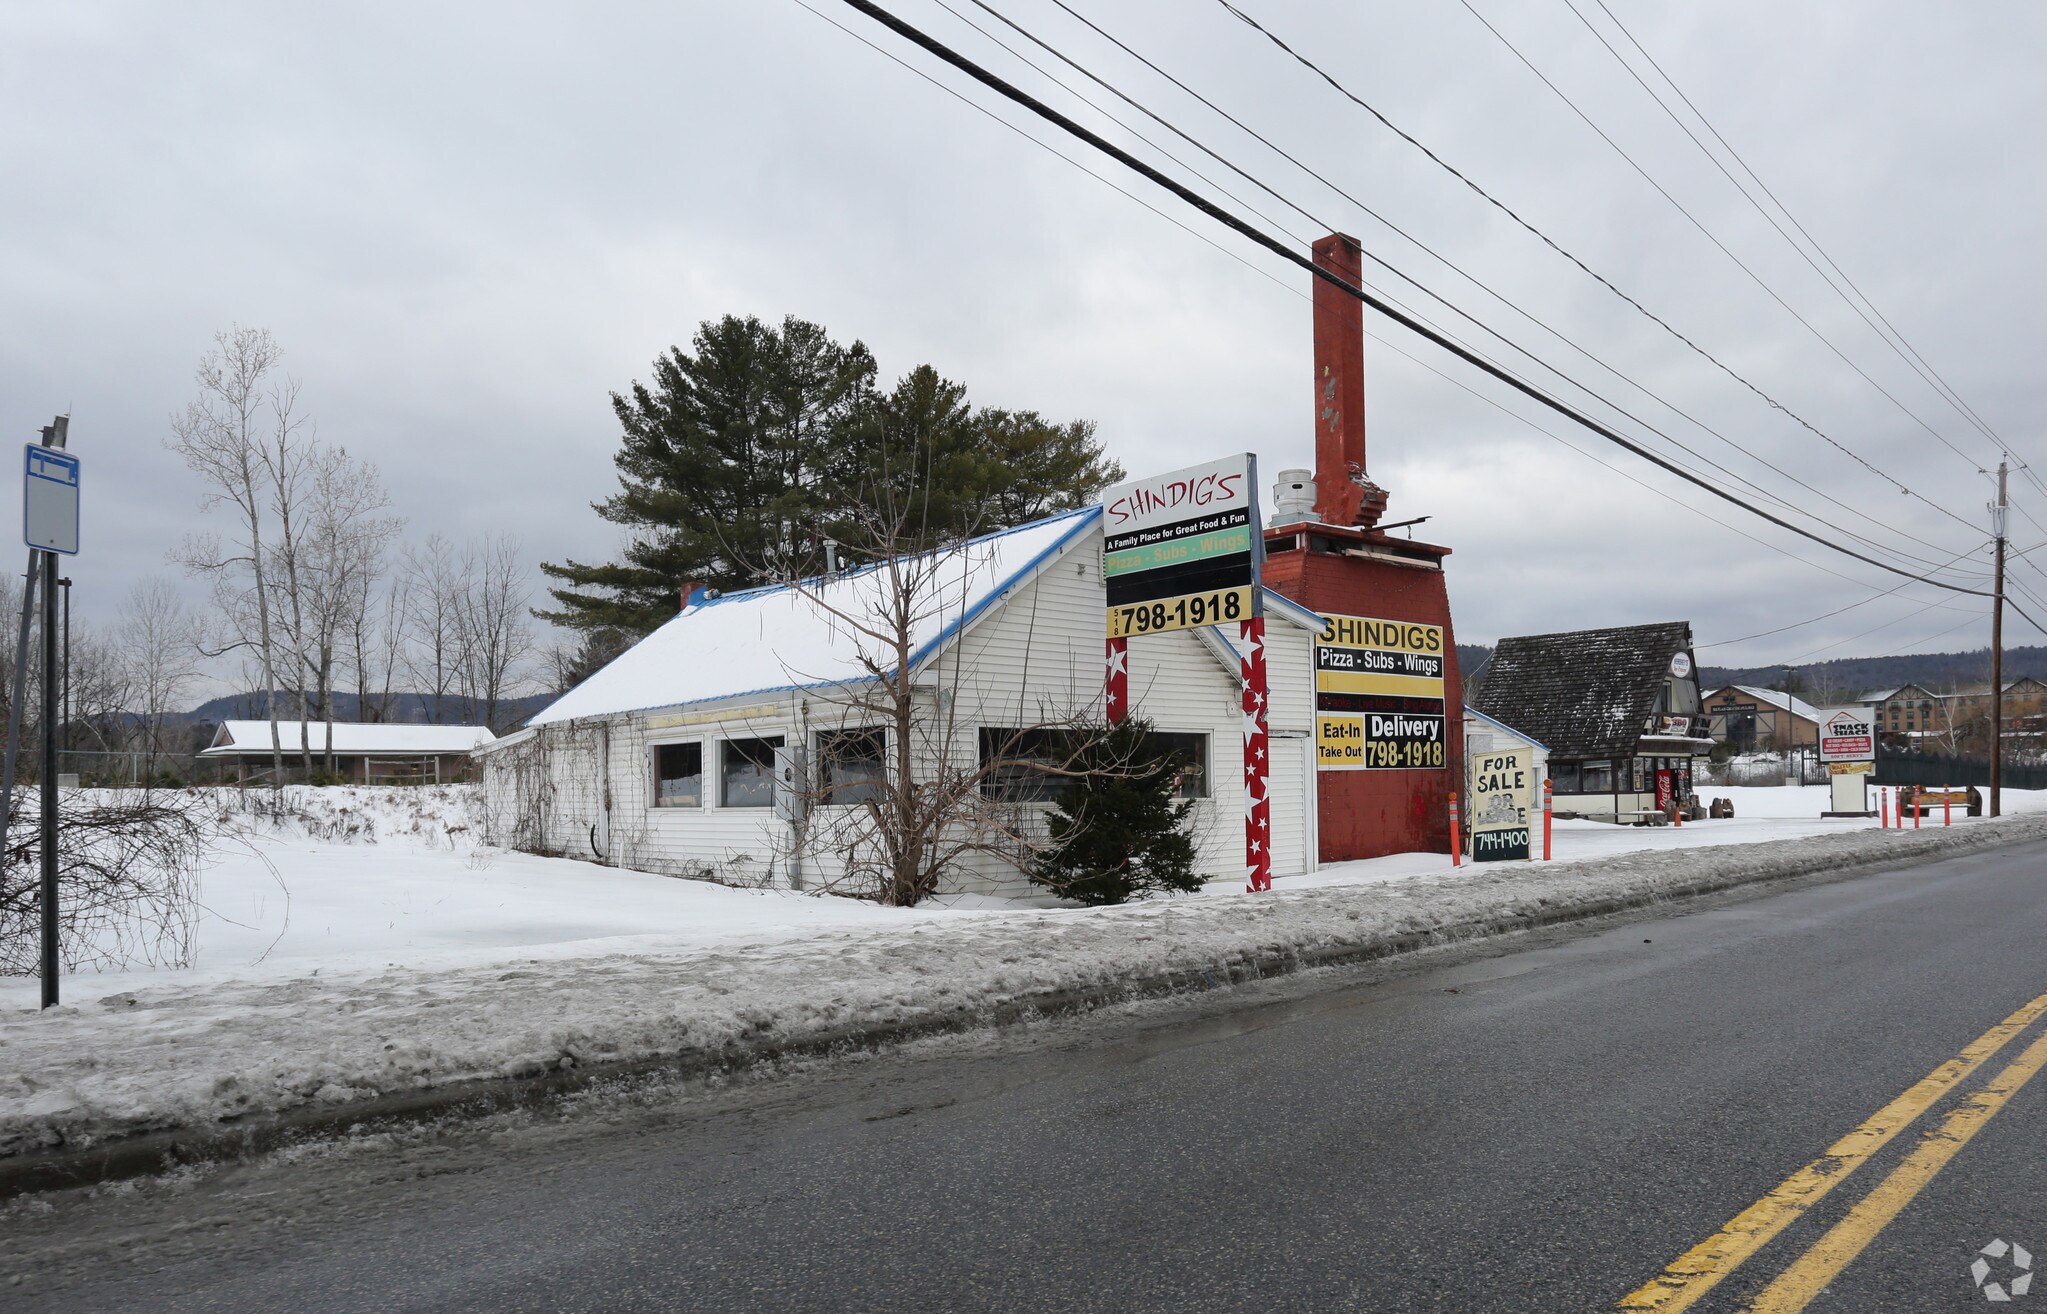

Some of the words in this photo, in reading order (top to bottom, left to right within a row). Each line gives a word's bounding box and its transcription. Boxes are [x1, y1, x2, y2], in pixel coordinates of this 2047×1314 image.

[1108, 472, 1242, 526] SHINDIG'S
[1108, 541, 1113, 550] A
[1114, 536, 1138, 548] Family
[1140, 531, 1160, 542] Place
[1162, 528, 1173, 538] for
[1176, 524, 1198, 536] Great
[1199, 518, 1218, 530] Food
[1221, 517, 1228, 526] &
[1230, 514, 1246, 524] Fun
[1108, 554, 1142, 571] Pizza
[1154, 546, 1188, 562] Subs
[1200, 533, 1246, 552] Wings
[1122, 592, 1240, 634] 798-1918
[1319, 618, 1440, 651] SHINDIGS
[1320, 648, 1354, 668] Pizza
[1364, 652, 1394, 670] Subs
[1404, 654, 1438, 676] Wings
[1324, 723, 1360, 738] Eat-In
[1372, 716, 1439, 740] Delivery
[1320, 746, 1342, 758] Take
[1345, 746, 1362, 758] Out
[1367, 741, 1442, 766] 798-1918
[1483, 756, 1518, 772] FOR
[1477, 772, 1524, 793] SALE
[1476, 830, 1529, 850] 744-1400
